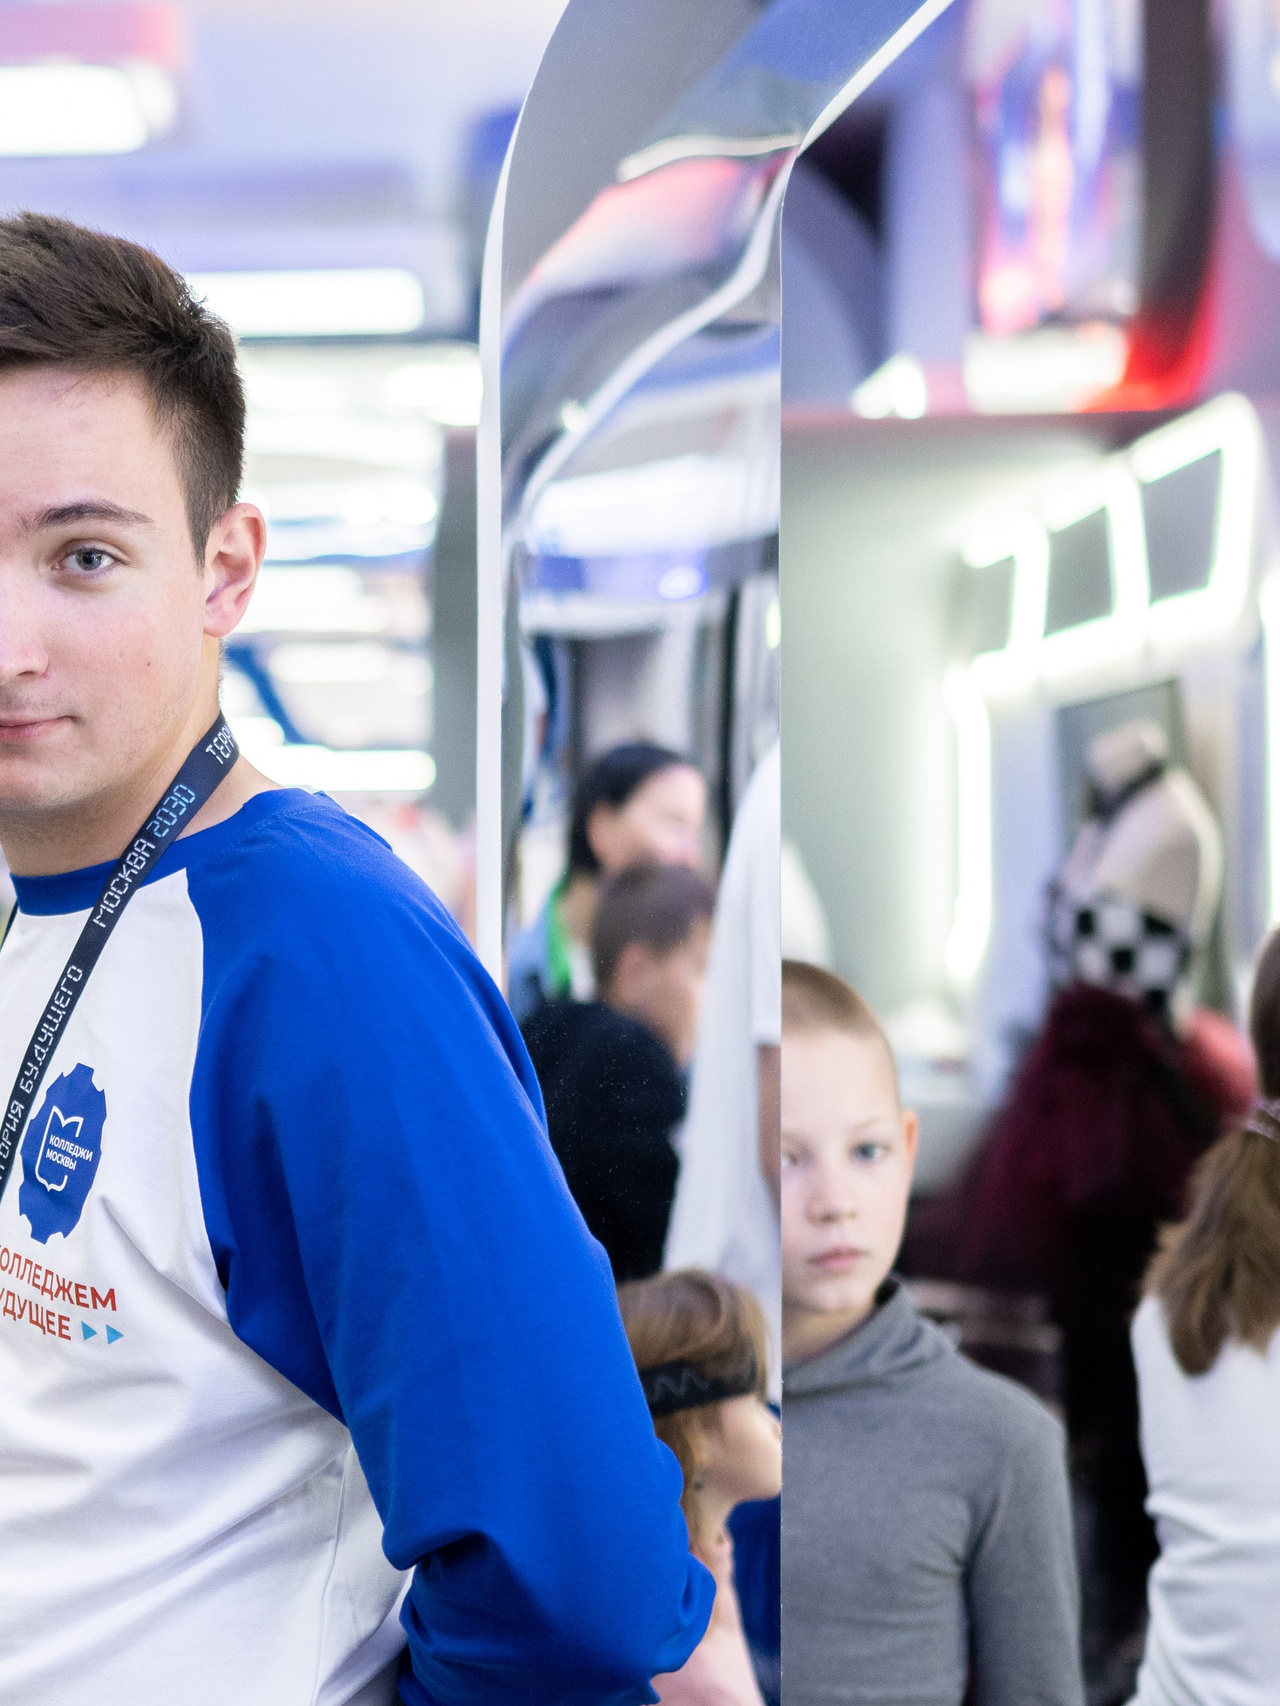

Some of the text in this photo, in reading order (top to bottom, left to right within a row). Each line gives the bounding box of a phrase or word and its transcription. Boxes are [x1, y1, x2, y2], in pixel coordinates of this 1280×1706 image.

[92, 783, 196, 929] МОСКВА 2030
[19, 964, 83, 1093] БУДУЩЕГО
[46, 1150, 77, 1171] МОСКВЫ
[49, 1133, 94, 1162] КОЛЛЕДЖИ
